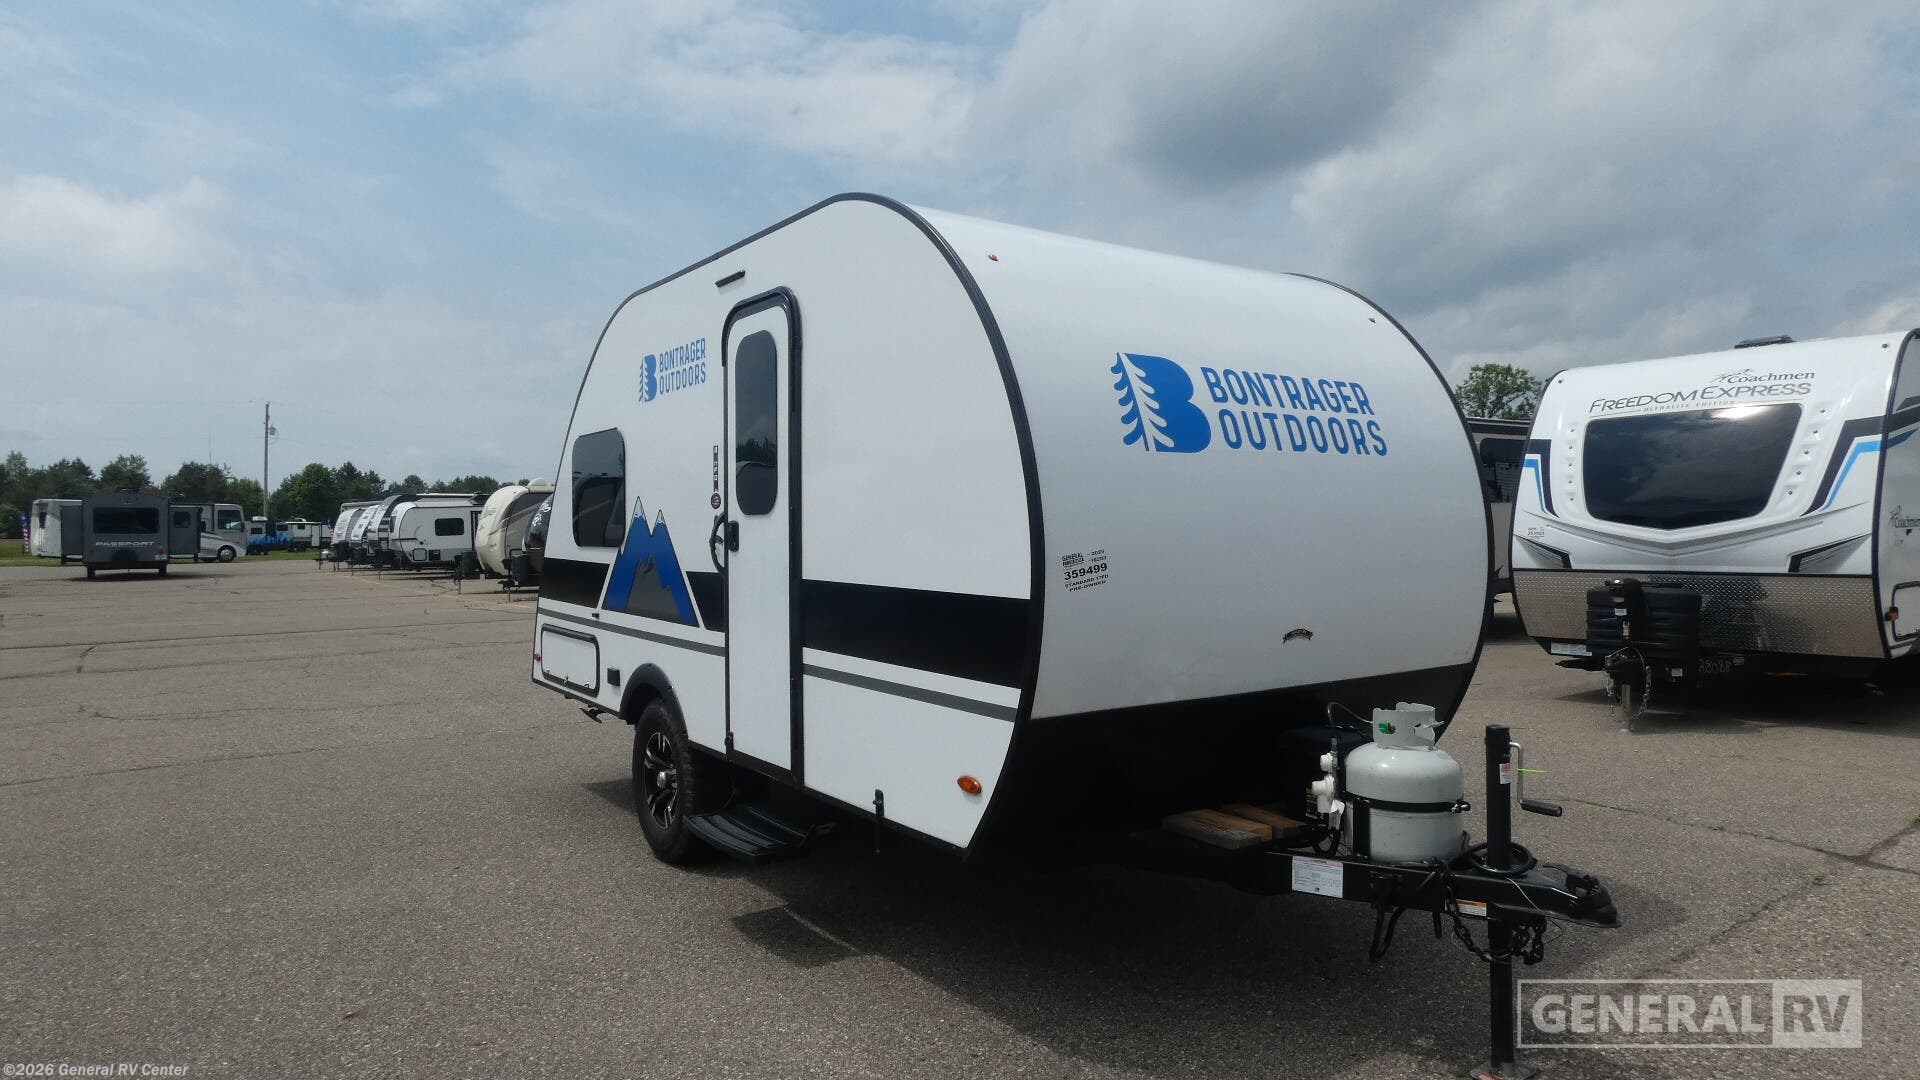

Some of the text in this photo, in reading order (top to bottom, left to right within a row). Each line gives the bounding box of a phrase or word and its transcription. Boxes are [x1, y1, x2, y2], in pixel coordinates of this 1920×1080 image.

[659, 338, 706, 373] BONTRAGER
[659, 361, 706, 395] OUTDOORS
[1200, 366, 1375, 415] BONTRAGER
[1727, 371, 1815, 384] Coachmen
[1589, 382, 1812, 414] FREEDOM EXPRESS
[1218, 408, 1388, 457] OUTDOORS
[1064, 562, 1107, 580] 359499
